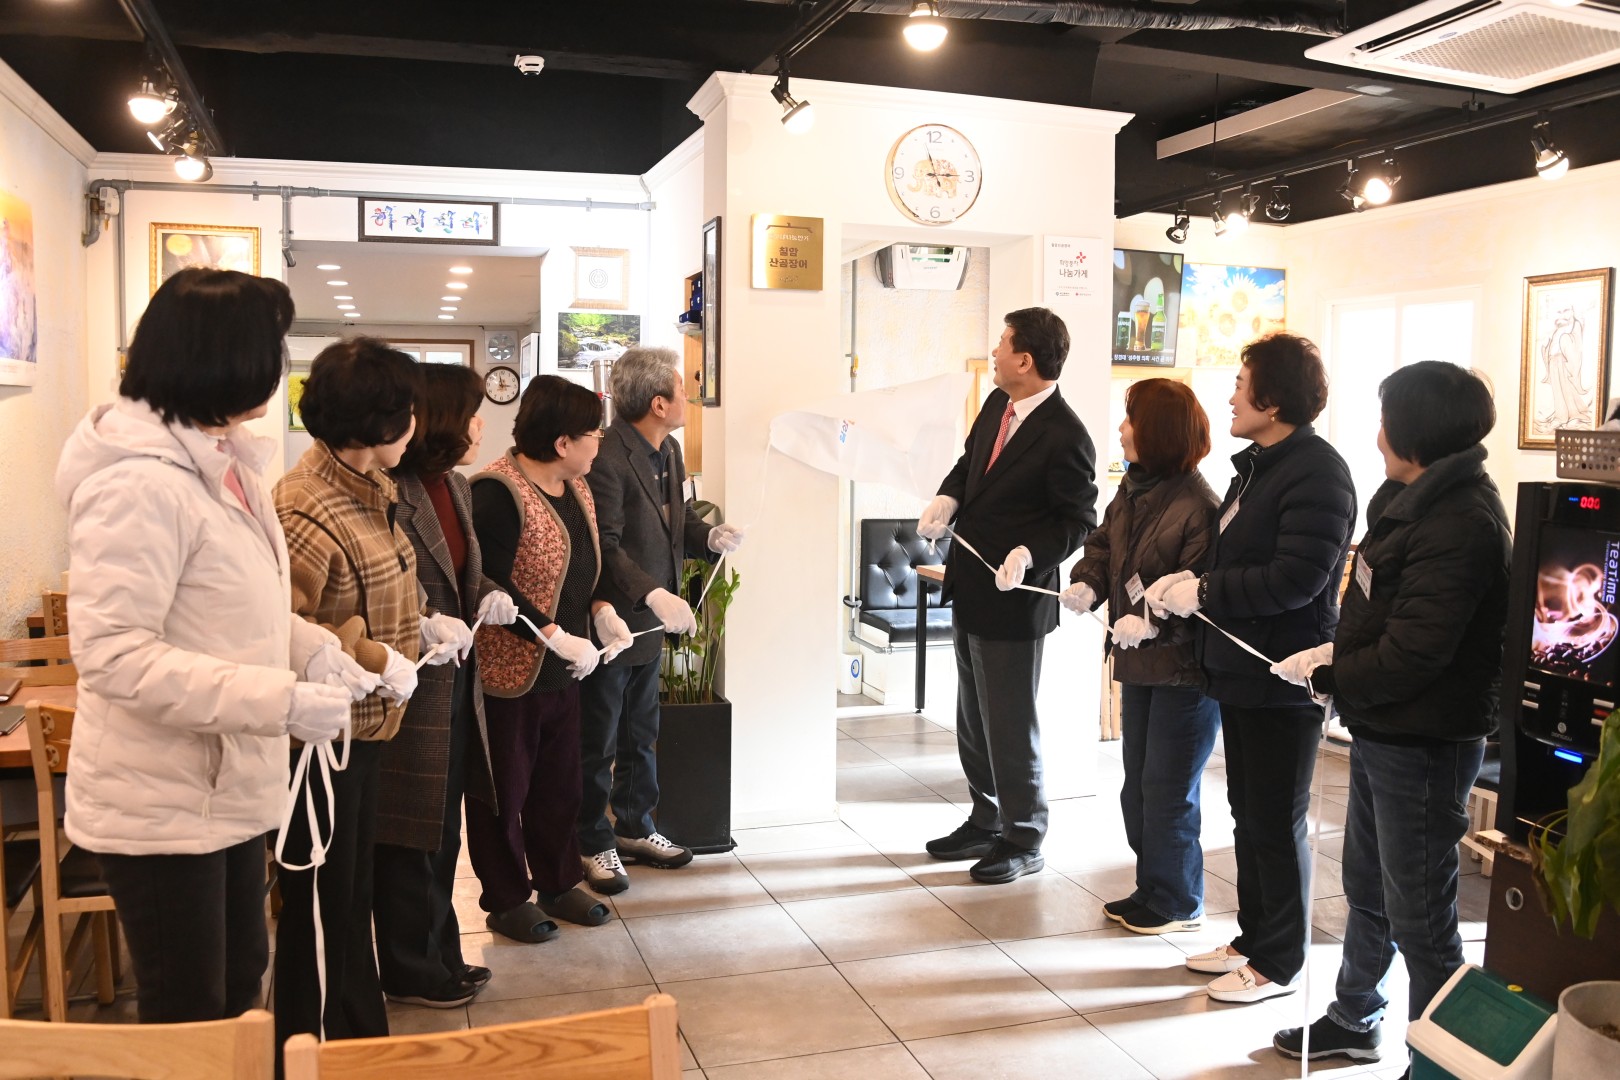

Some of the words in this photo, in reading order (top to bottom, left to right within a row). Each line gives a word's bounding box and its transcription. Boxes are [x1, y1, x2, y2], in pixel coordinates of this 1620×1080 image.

[926, 131, 942, 143] 12
[894, 167, 904, 179] 9
[965, 170, 975, 183] 3
[930, 206, 940, 219] 6
[769, 258, 808, 269] 산곰장어
[1059, 268, 1088, 279] 나눔가게
[1580, 496, 1600, 510] 000
